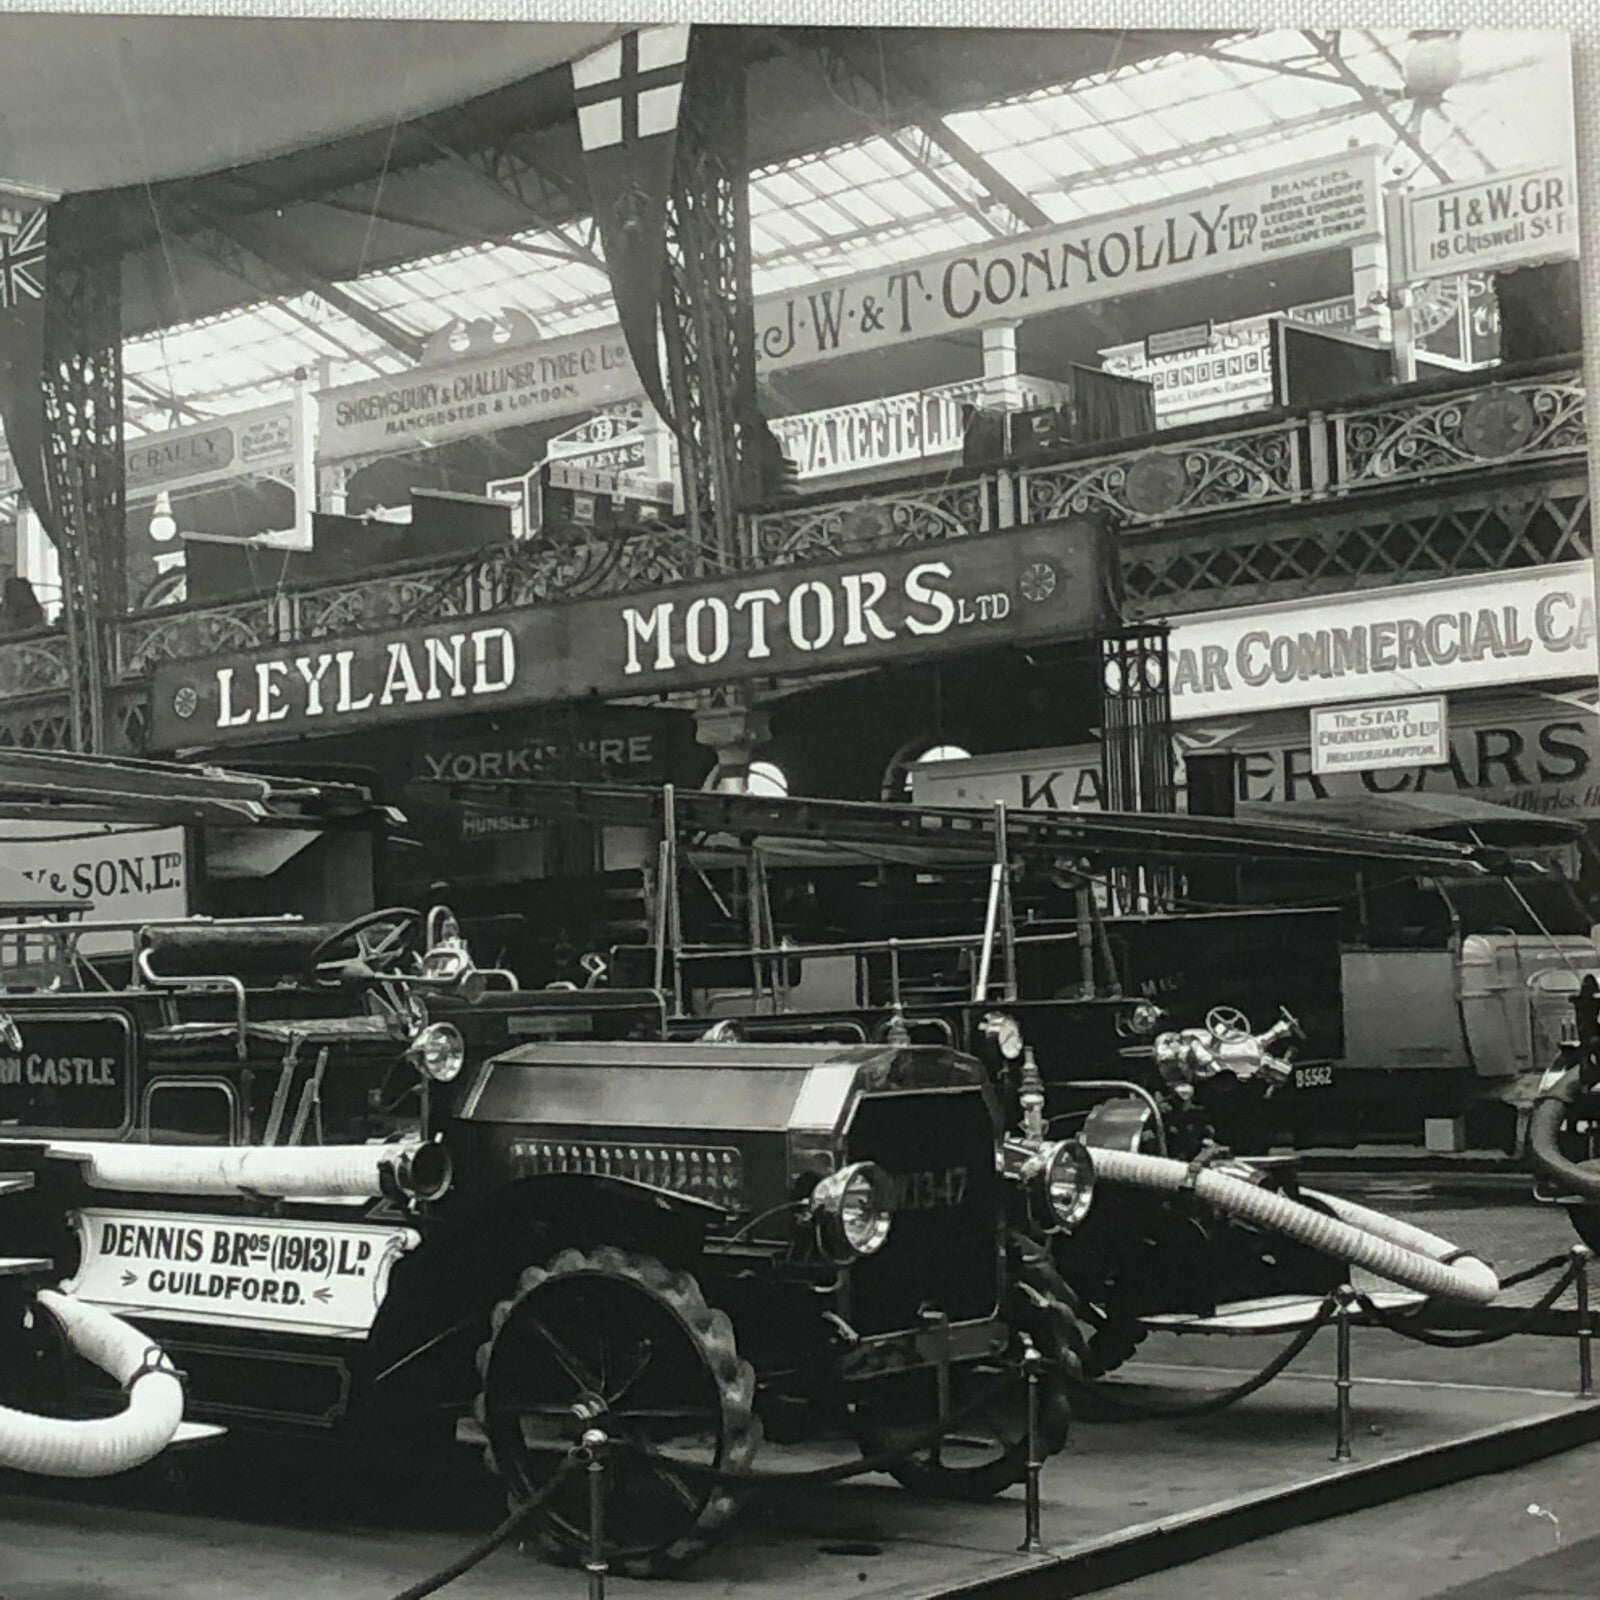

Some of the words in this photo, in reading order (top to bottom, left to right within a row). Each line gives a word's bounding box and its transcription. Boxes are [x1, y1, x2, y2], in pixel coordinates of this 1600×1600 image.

[943, 203, 1230, 320] CONNOLLY
[541, 348, 579, 384] TYRE
[215, 627, 517, 728] LEYLAND
[622, 561, 956, 675] MOTORS
[957, 592, 1011, 625] LTD
[1236, 606, 1533, 688] COMMERCIAL
[1360, 708, 1410, 726] STAR
[424, 734, 654, 780] YORKRE
[26, 1052, 116, 1086] CASTLE
[99, 1222, 204, 1263] DENNIS
[147, 1269, 307, 1306] GUILDFORD.
